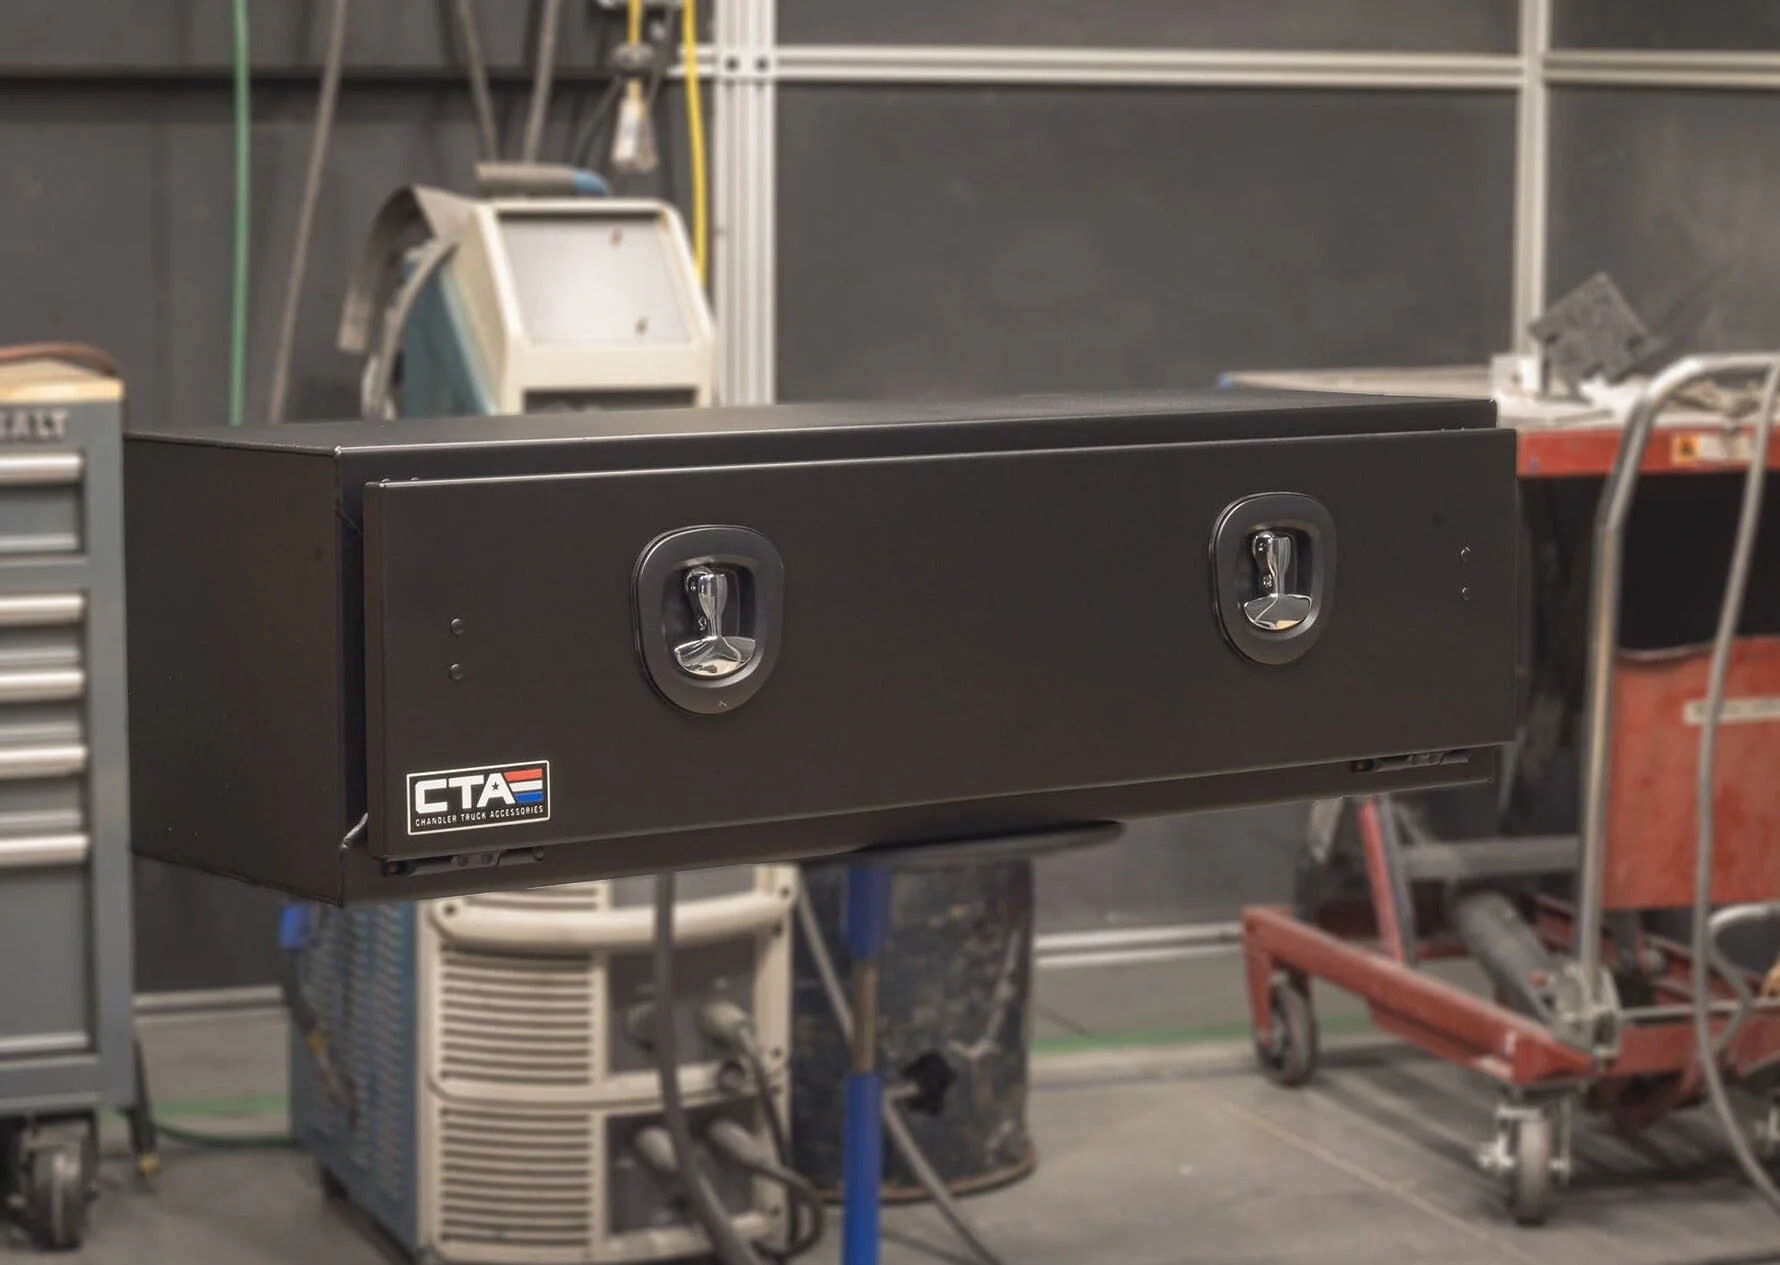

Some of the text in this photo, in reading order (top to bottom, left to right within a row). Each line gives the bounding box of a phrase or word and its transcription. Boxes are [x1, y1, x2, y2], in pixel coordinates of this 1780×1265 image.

[415, 772, 516, 814] CTA
[415, 805, 544, 827] CHANDLER TRUCK ACCESSORIES
